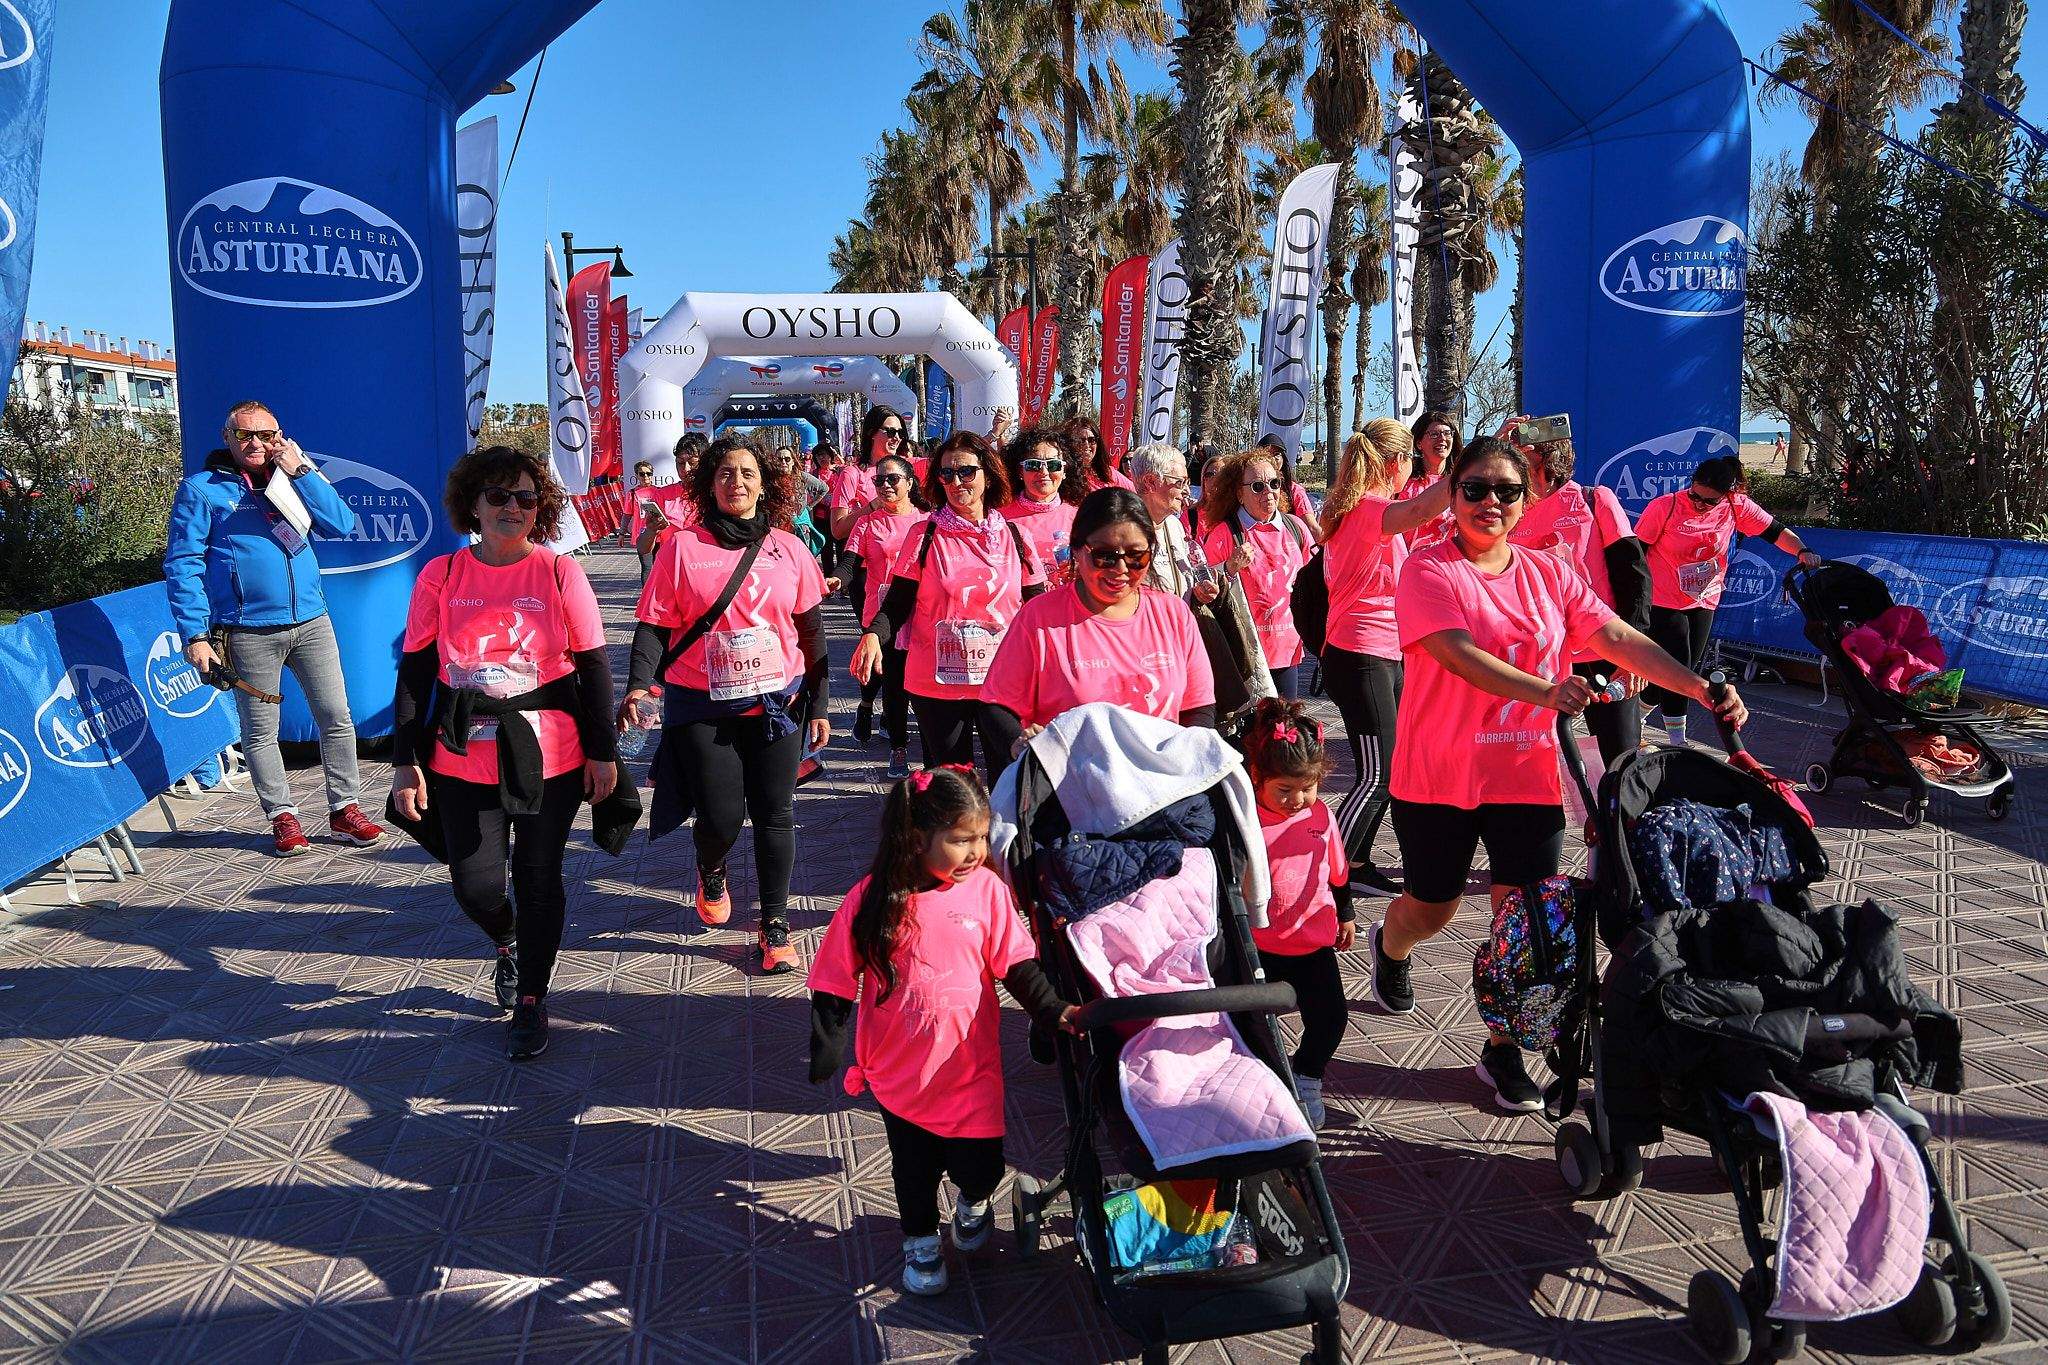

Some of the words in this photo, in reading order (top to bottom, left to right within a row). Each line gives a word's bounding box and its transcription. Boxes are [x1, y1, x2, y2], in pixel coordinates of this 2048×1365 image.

[214, 221, 299, 235] CENTRAL
[309, 224, 398, 247] LECHERA
[187, 225, 408, 285] ASTURIANA
[1651, 250, 1715, 262] CENTRAL
[742, 306, 900, 339] OYSHO
[1113, 283, 1134, 376] Santander
[1267, 207, 1320, 427] OYSHO
[584, 290, 600, 383] Santander
[946, 340, 992, 352] OYSHO
[646, 344, 695, 356] OYSHO
[1033, 323, 1054, 394] Santander
[1148, 271, 1192, 441] OYSHO
[627, 410, 673, 421] OYSHO
[731, 403, 798, 412] VOLVO
[1109, 403, 1126, 457] Sports
[1645, 461, 1702, 472] CENTRA
[733, 658, 761, 672] 016
[960, 648, 986, 660] 016
[52, 696, 145, 757] ASTURIANA
[1474, 732, 1515, 744] CARRERA
[1516, 731, 1528, 742] DE
[1529, 730, 1539, 741] LA
